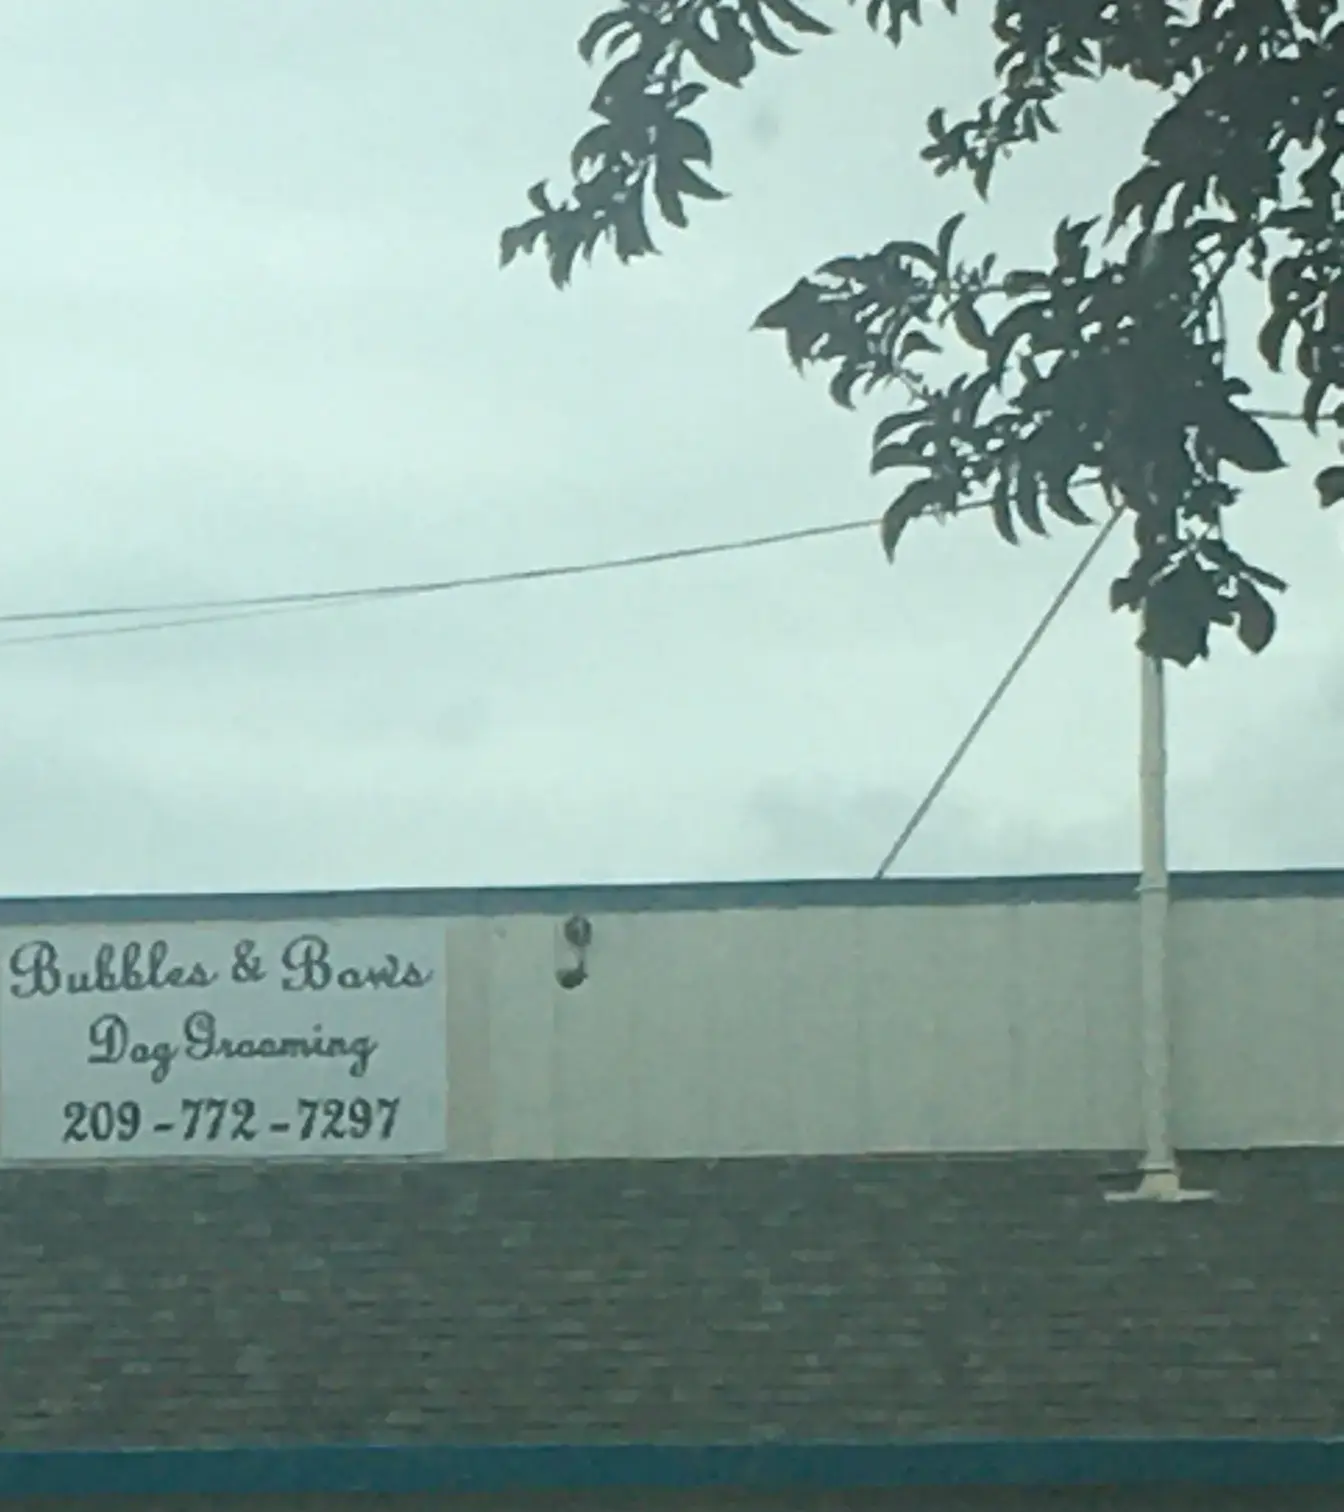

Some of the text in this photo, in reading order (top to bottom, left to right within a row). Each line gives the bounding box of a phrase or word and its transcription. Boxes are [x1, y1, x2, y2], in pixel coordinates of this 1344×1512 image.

[9, 939, 218, 998] Bubbles
[231, 939, 266, 984] &
[87, 1010, 378, 1083] Dog Grooming
